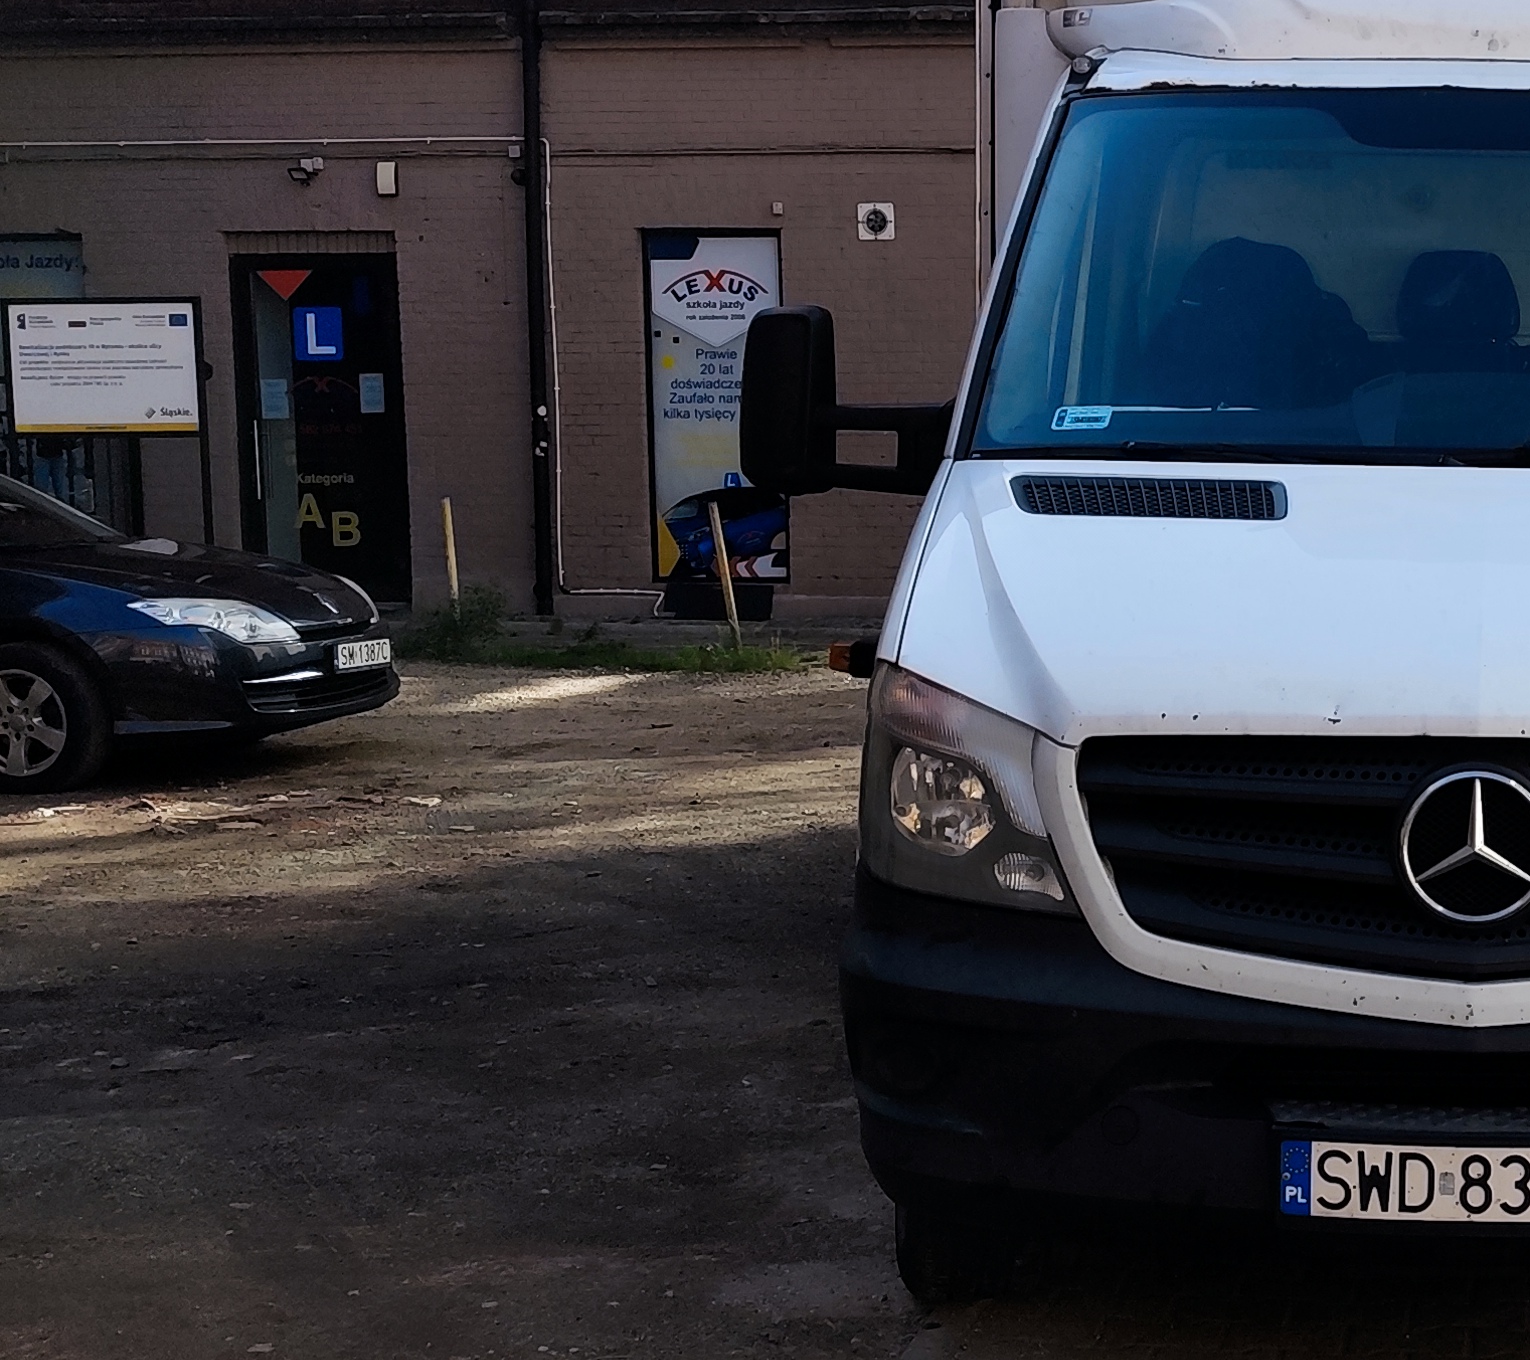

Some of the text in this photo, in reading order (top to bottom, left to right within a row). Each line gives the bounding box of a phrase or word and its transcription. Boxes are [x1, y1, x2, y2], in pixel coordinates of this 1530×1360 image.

[670, 269, 760, 303] LEXUS
[686, 300, 745, 310] szkoła jazdy
[306, 312, 337, 355] L
[696, 348, 738, 360] Prawie
[700, 363, 734, 375] 20 lat
[669, 392, 715, 404] Zaufało
[663, 408, 736, 422] kilka tysięcy
[331, 511, 361, 547] B
[359, 641, 388, 663] 1387C
[1285, 1186, 1308, 1204] PL
[1316, 1148, 1436, 1214] SWD
